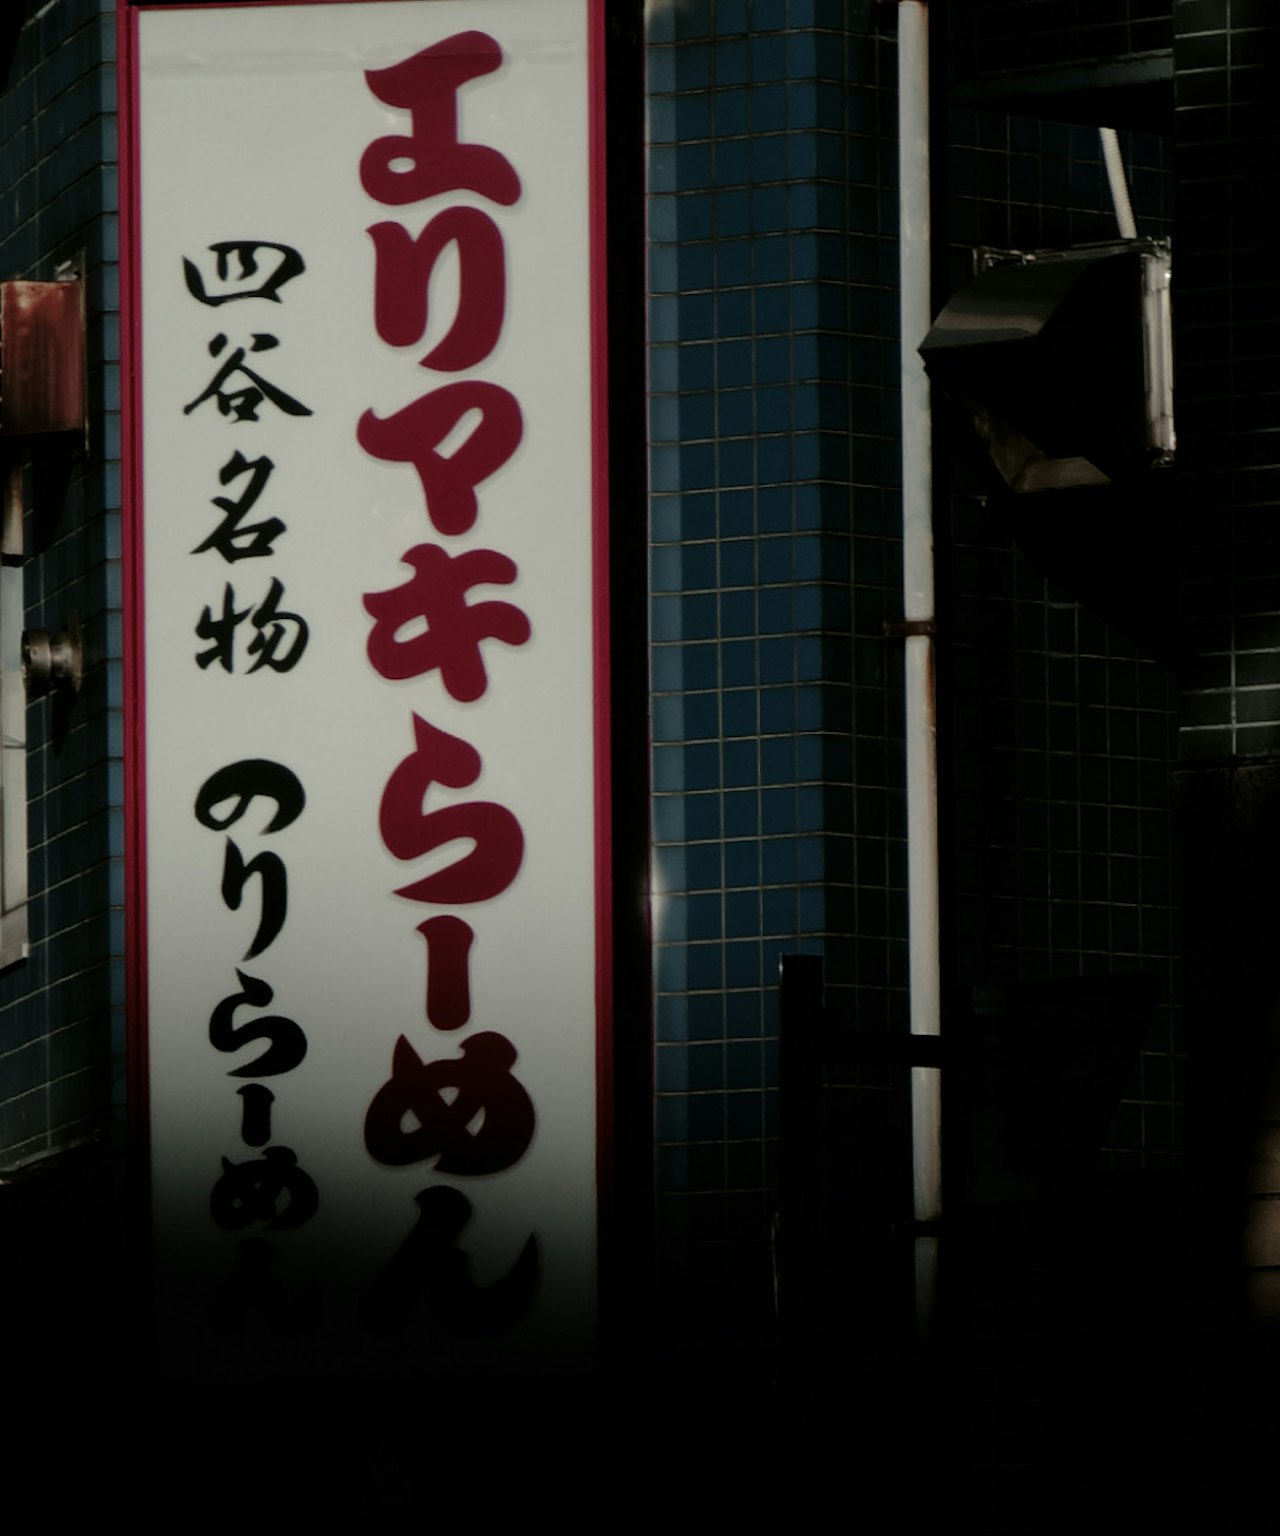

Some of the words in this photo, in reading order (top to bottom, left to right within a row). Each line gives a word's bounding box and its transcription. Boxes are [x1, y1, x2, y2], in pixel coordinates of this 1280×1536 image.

[182, 240, 314, 676] 四谷名物
[194, 758, 320, 1334] のりらーめん
